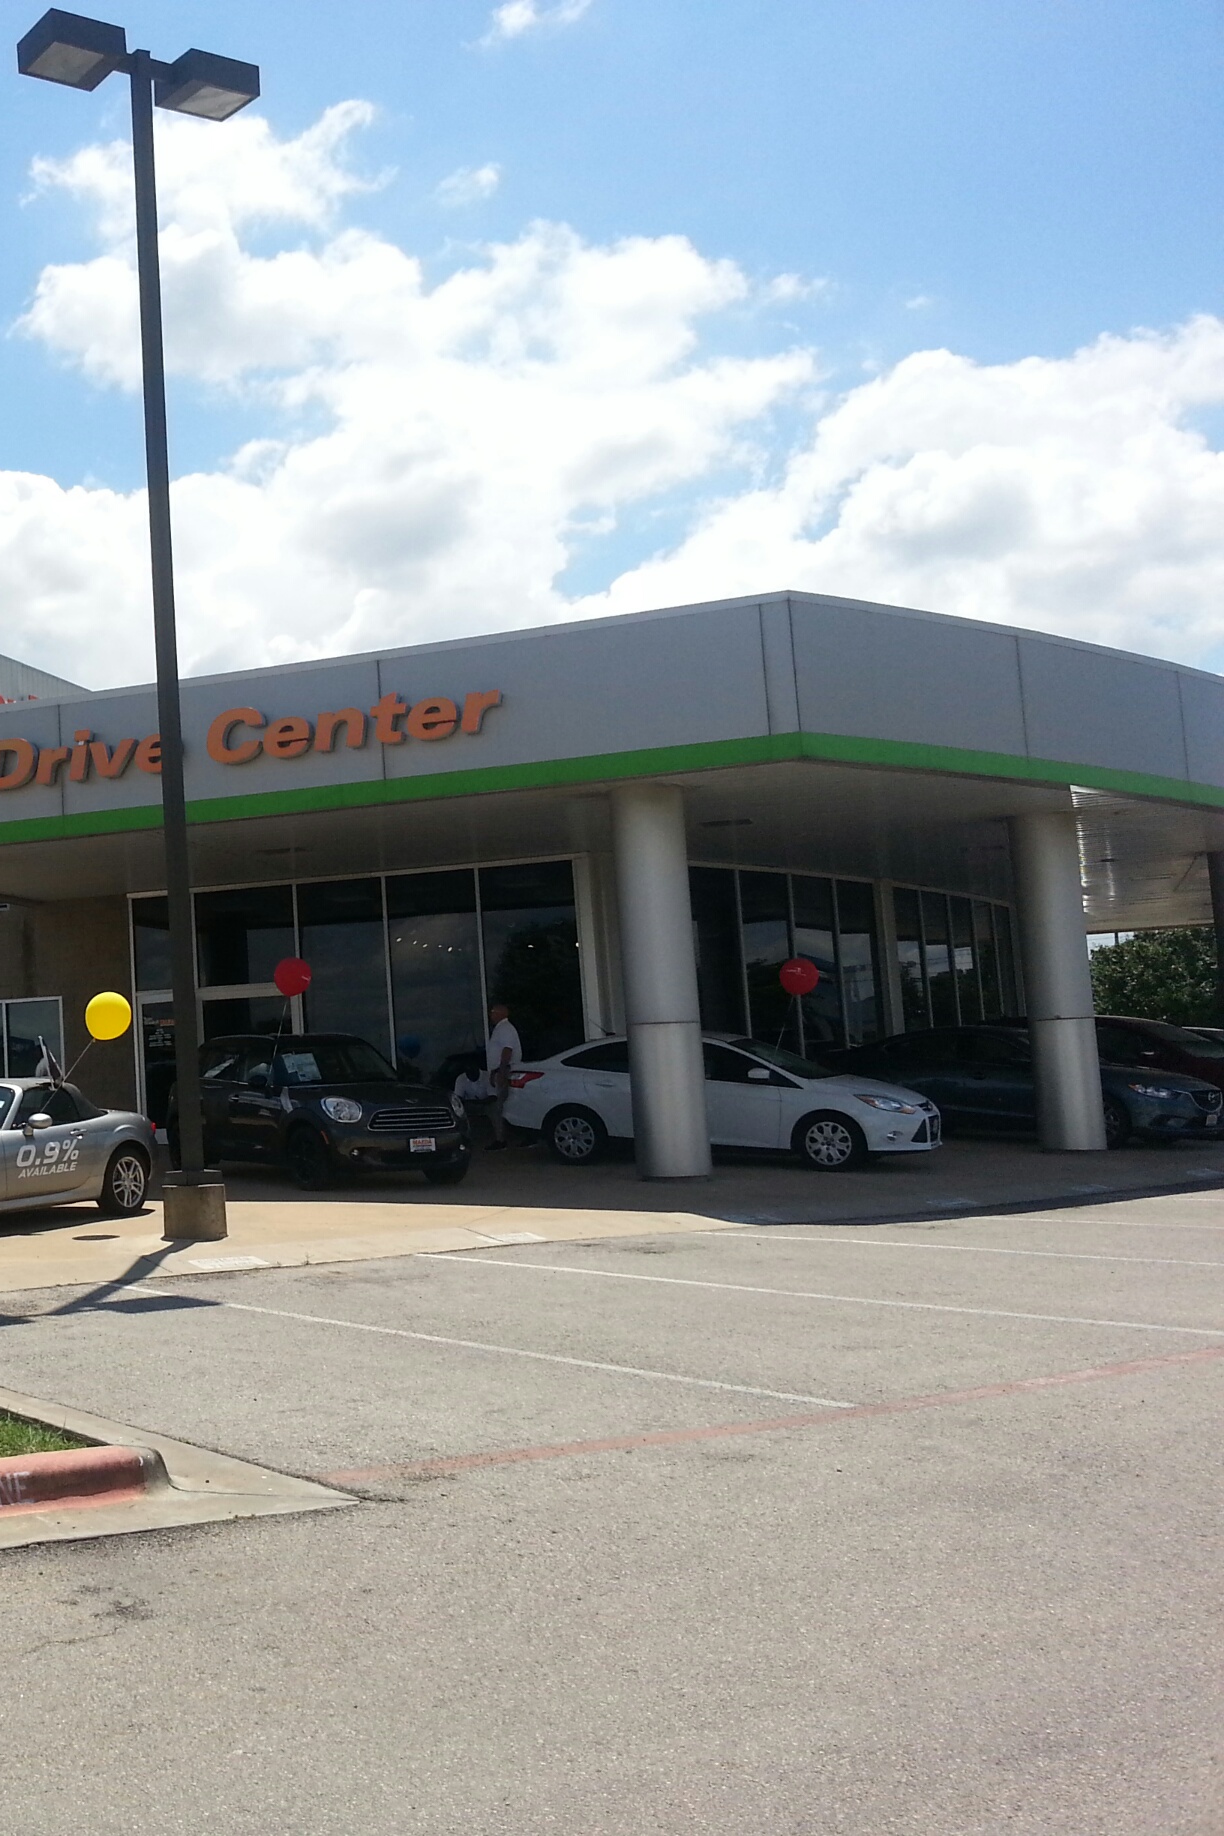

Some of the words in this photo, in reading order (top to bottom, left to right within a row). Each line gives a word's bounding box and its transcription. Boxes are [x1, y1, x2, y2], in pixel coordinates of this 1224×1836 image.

[206, 689, 502, 765] Center
[17, 1139, 79, 1167] 0.9%
[18, 1162, 78, 1178] AVAILABLE
